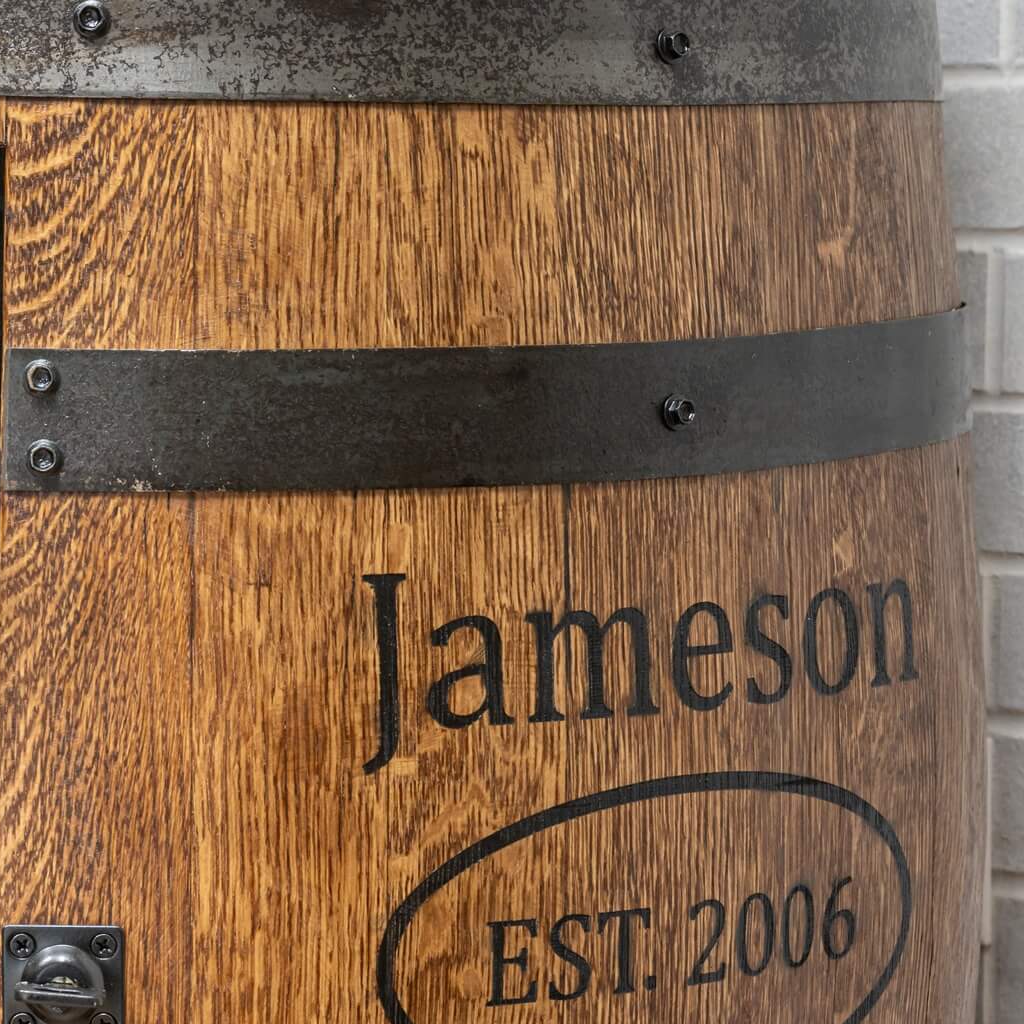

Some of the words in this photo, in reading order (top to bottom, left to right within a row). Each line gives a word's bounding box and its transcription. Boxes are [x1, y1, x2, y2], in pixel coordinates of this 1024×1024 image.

[362, 573, 919, 774] Jameson
[486, 907, 657, 1006] EST.
[688, 877, 857, 986] 2006
